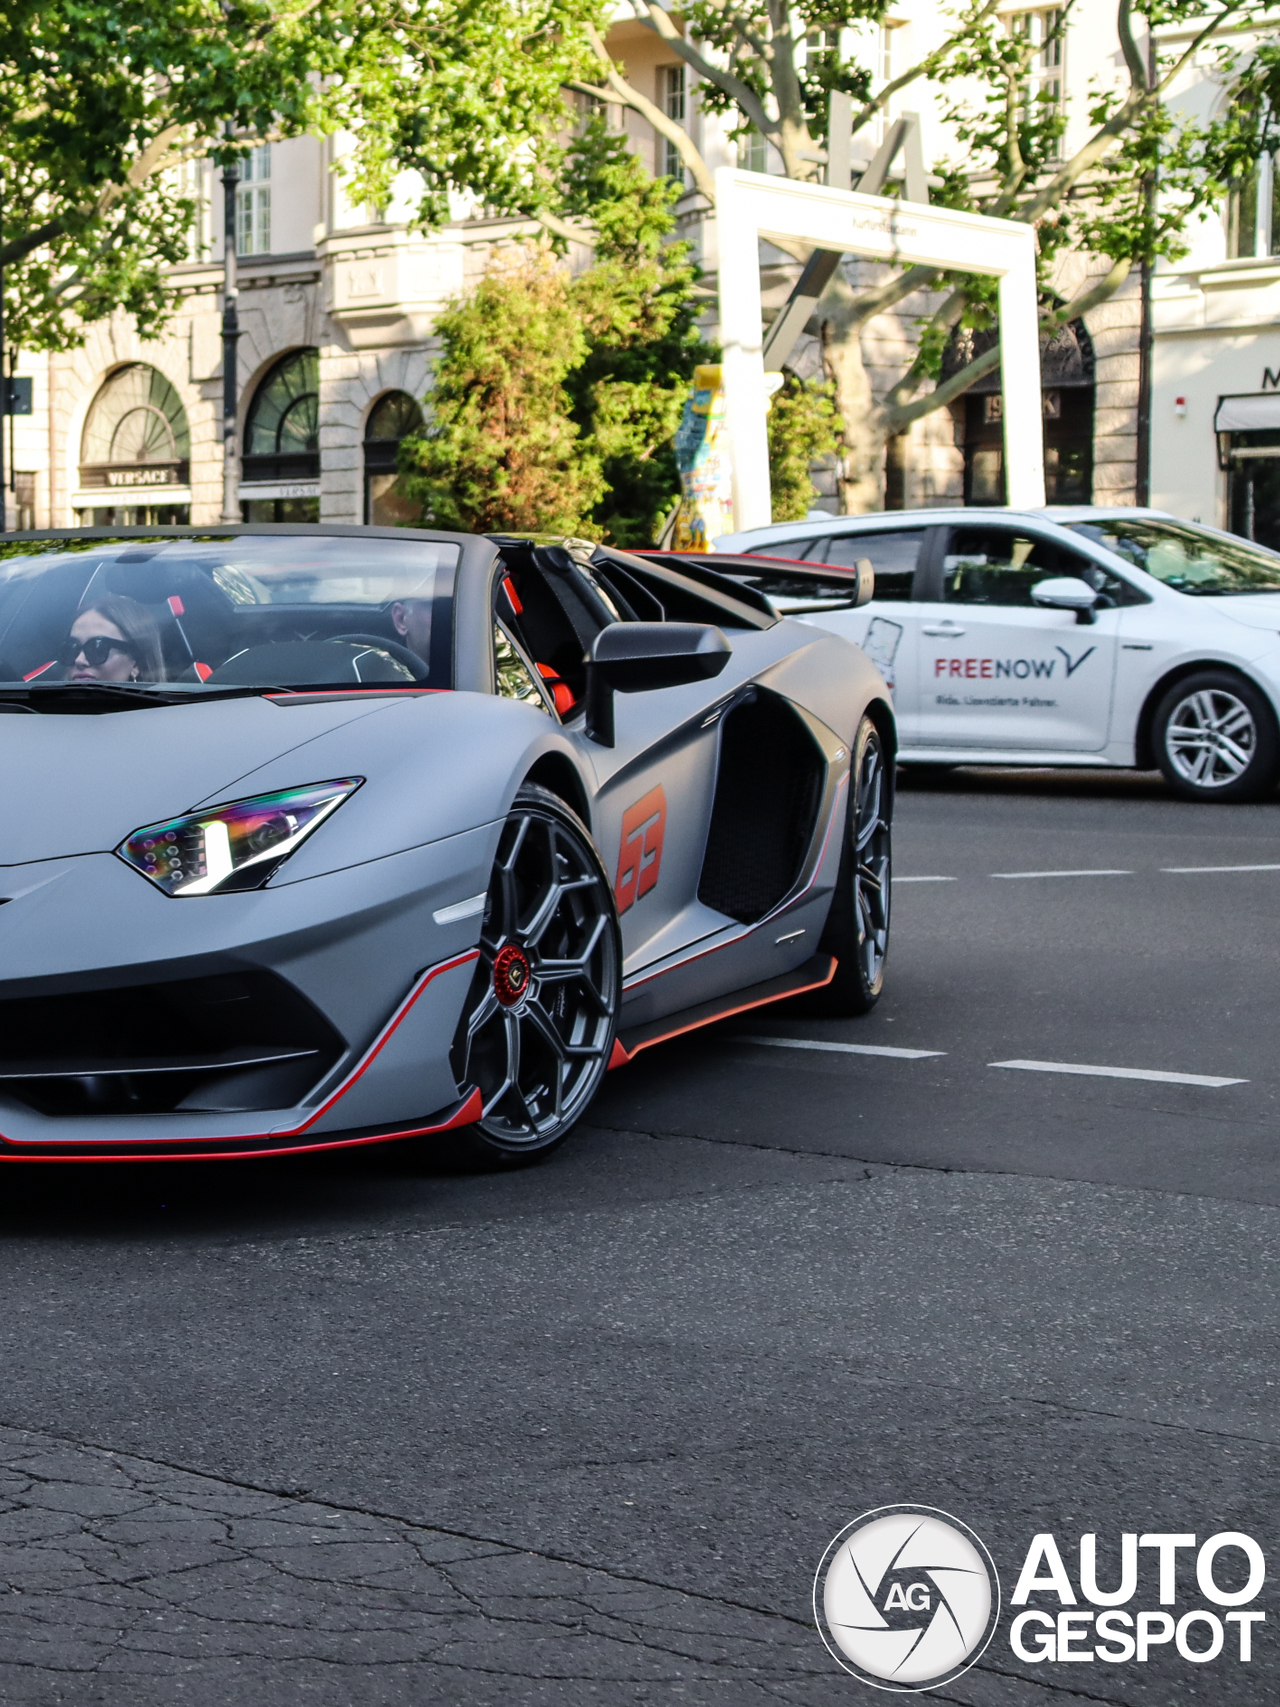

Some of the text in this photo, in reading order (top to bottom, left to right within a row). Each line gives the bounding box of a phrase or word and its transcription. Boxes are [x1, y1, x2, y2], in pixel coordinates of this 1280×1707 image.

[108, 469, 169, 486] VERSACE
[934, 658, 1056, 679] FREENOW
[613, 783, 668, 918] 63
